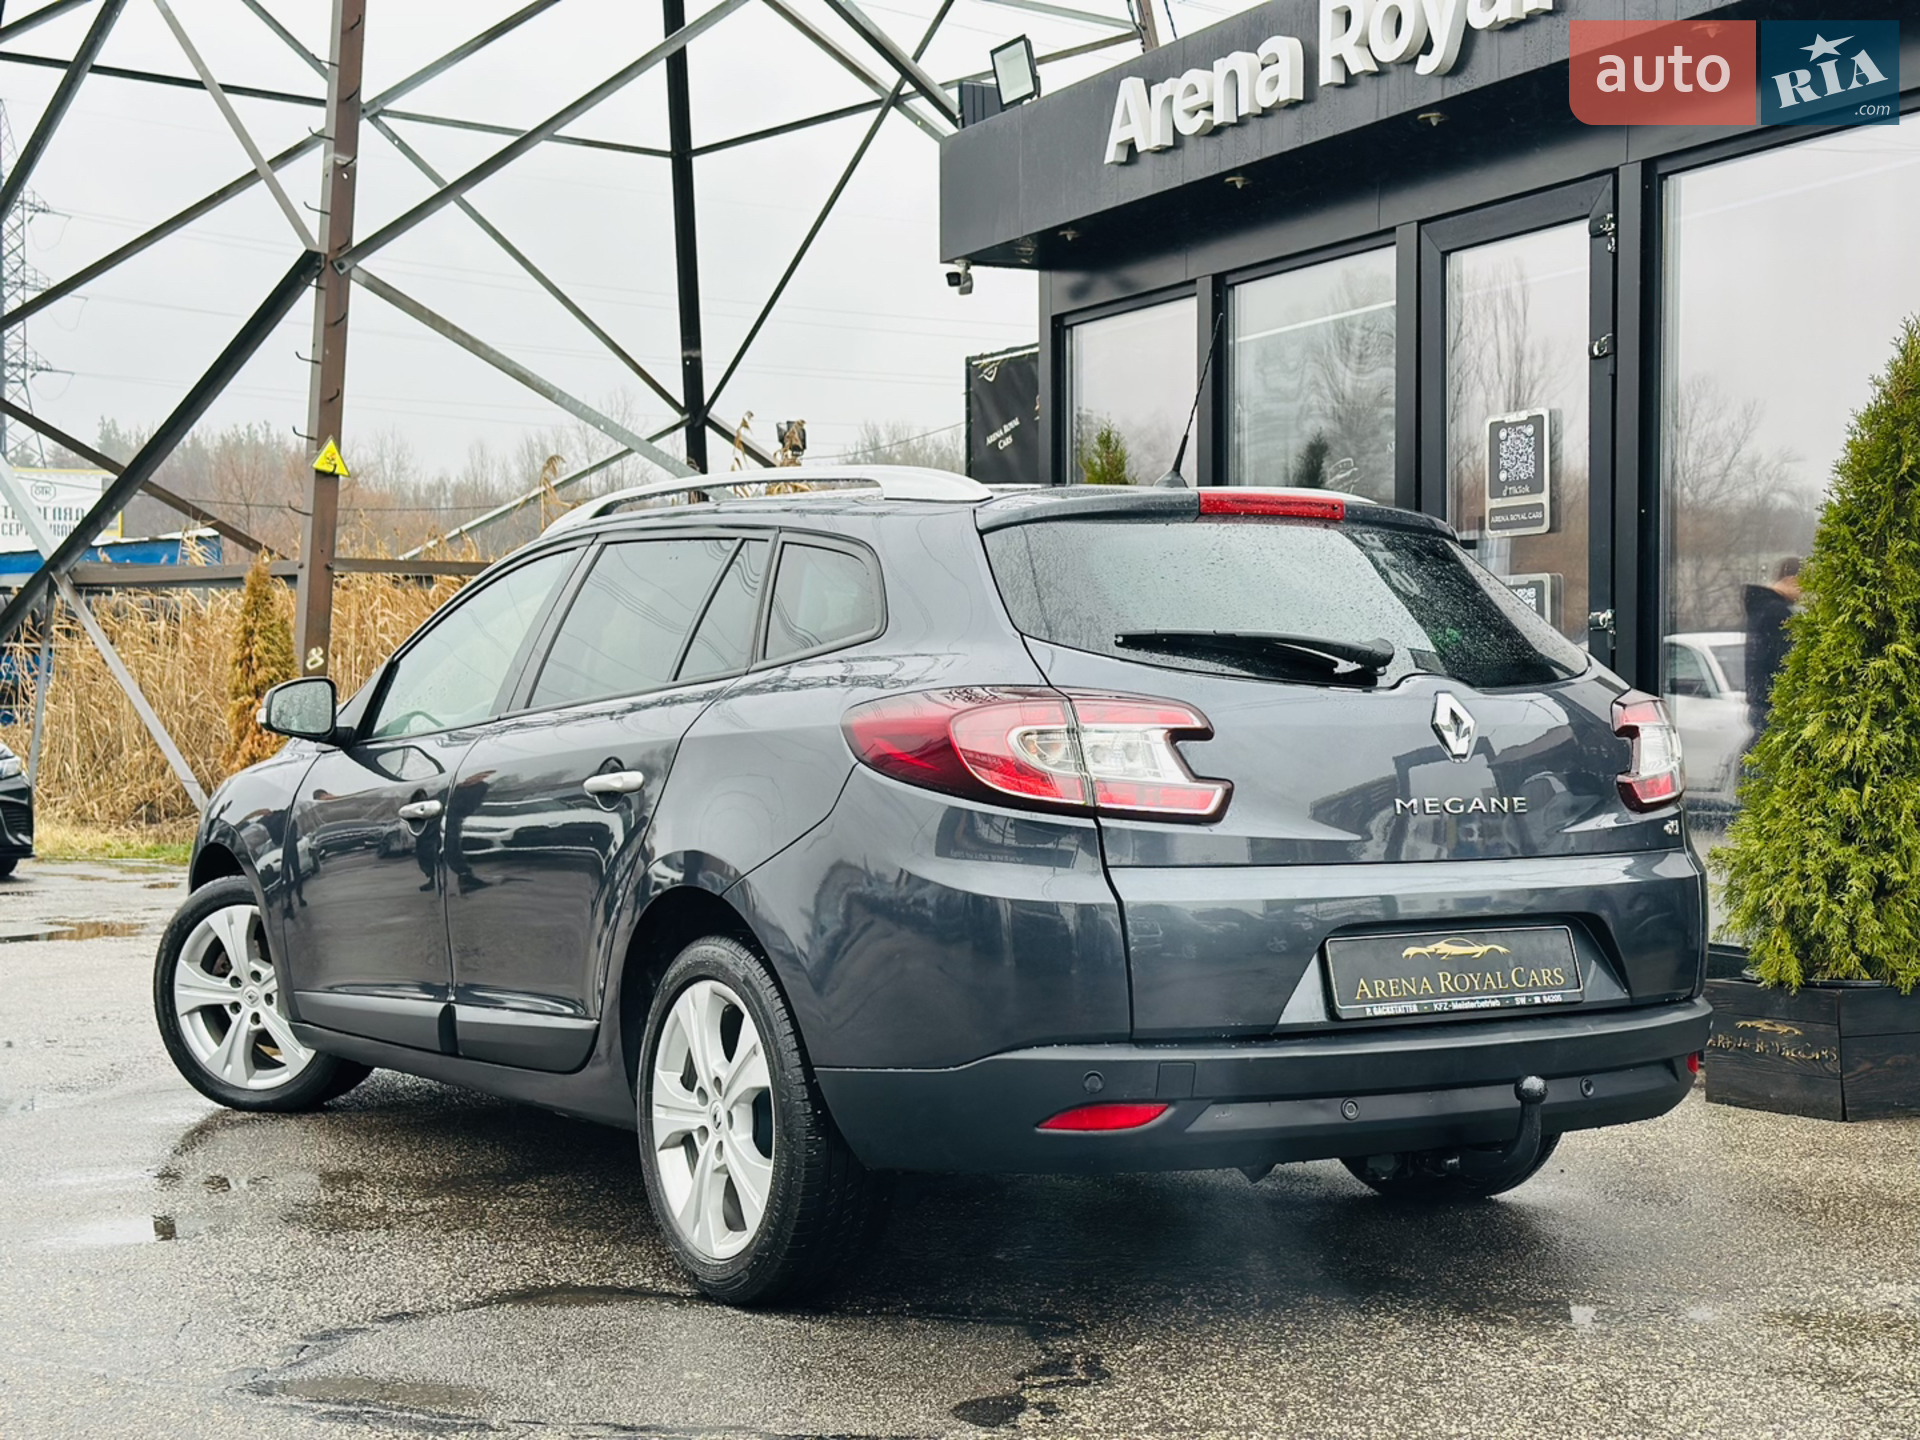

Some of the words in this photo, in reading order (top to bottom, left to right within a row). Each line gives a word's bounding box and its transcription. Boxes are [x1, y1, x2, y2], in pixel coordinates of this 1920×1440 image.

[1104, 35, 1304, 164] Arena
[1319, 0, 1554, 87] Roy
[1508, 484, 1530, 495] TikTok
[1491, 514, 1509, 523] ARENA
[1510, 512, 1527, 521] ROYAL
[1528, 510, 1543, 520] CARS
[1394, 796, 1528, 815] MEGANE
[1355, 976, 1434, 1000] ARENA
[1437, 970, 1509, 993] ROYAL
[1511, 966, 1566, 988] CARS
